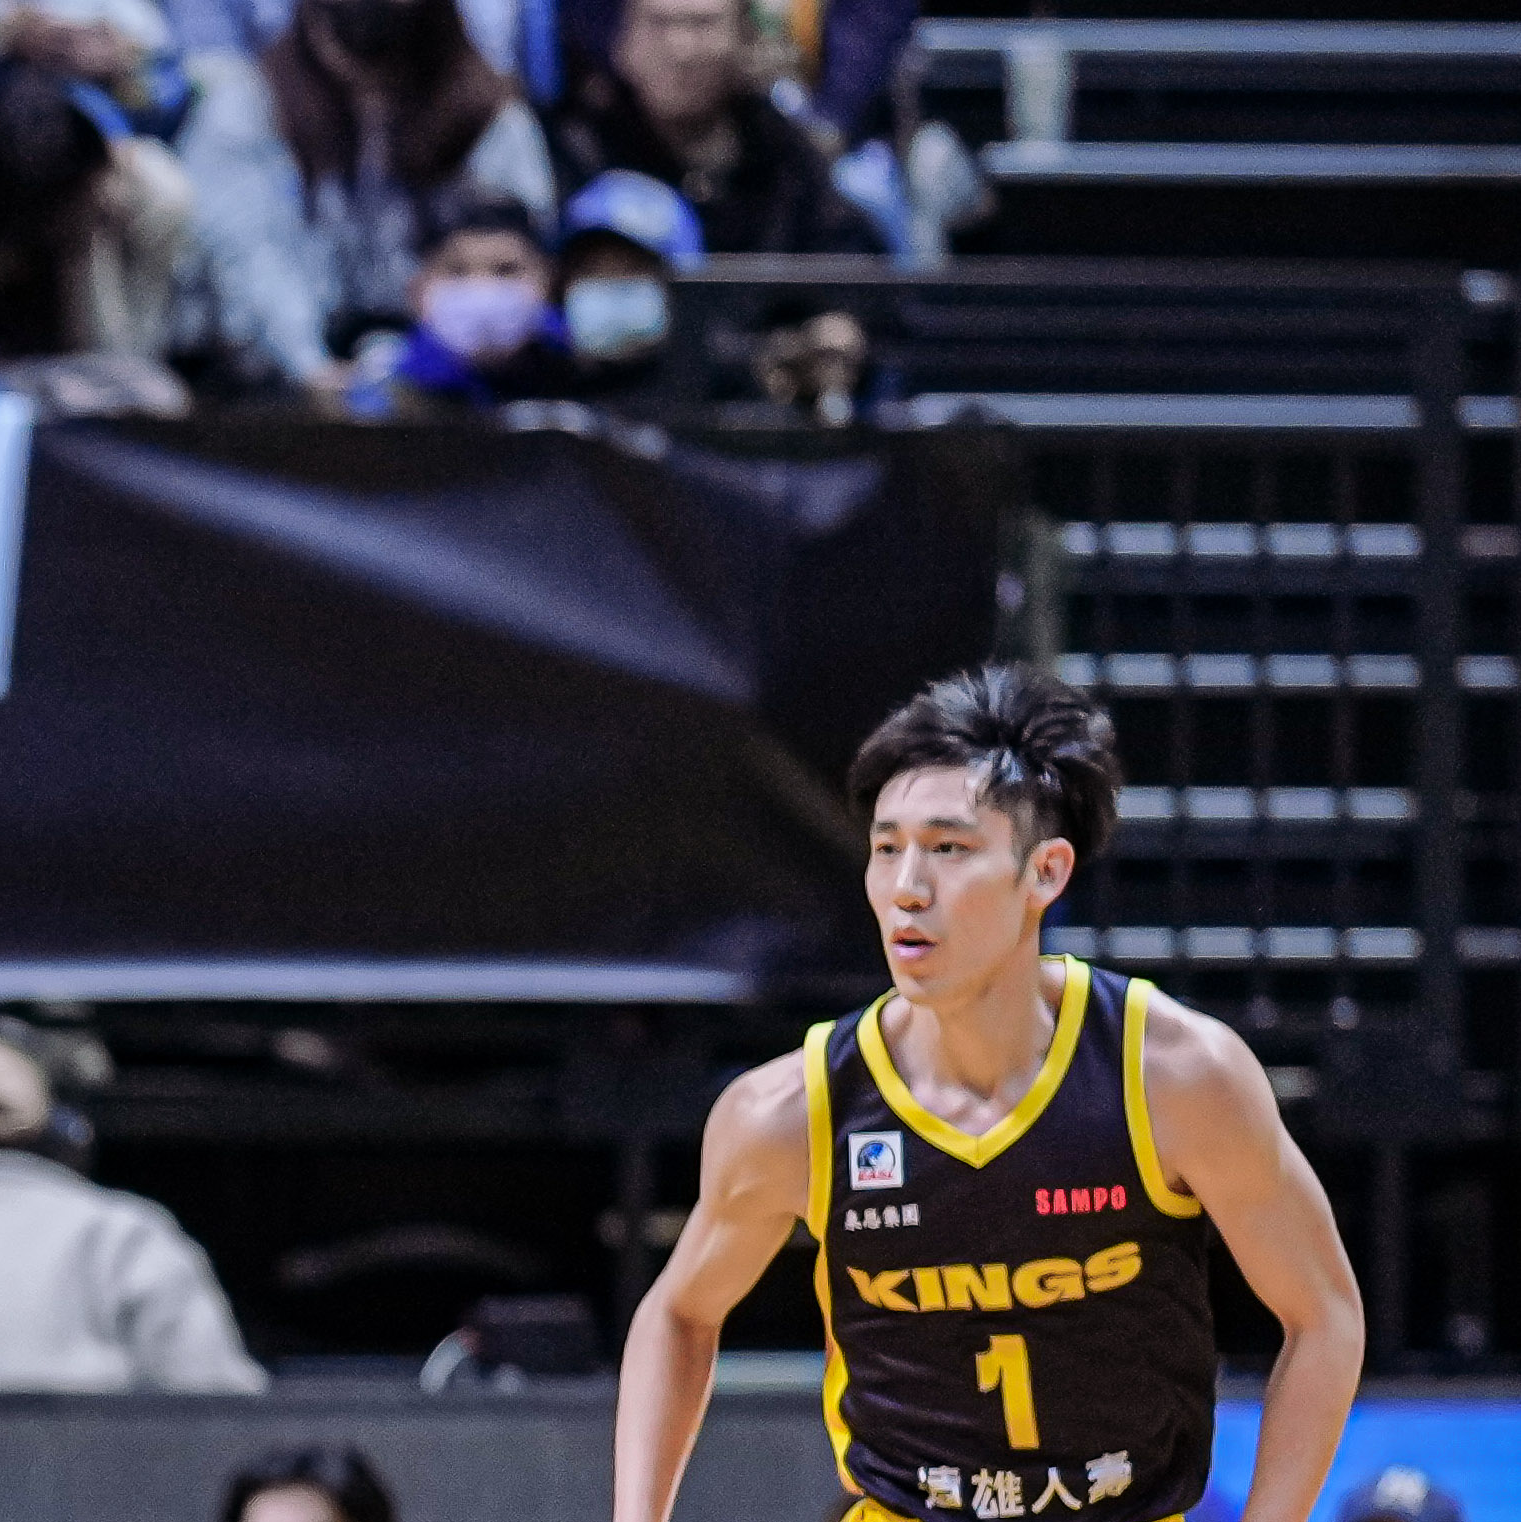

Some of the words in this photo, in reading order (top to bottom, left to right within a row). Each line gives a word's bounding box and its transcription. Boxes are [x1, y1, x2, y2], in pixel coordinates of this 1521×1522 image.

[1035, 1185, 1127, 1215] SAMPO
[846, 1241, 1142, 1312] KINGS
[975, 1334, 1039, 1450] 1
